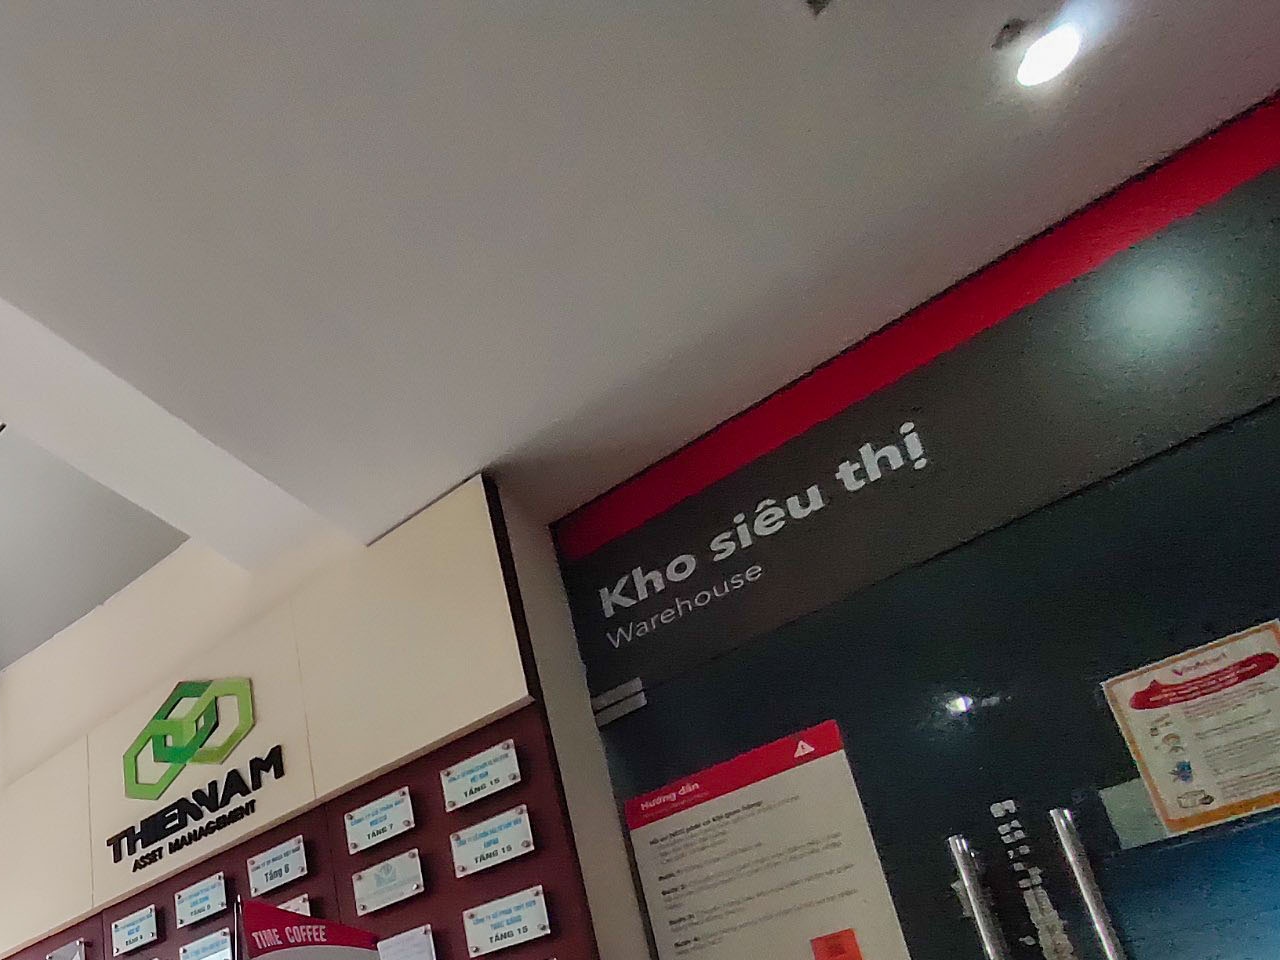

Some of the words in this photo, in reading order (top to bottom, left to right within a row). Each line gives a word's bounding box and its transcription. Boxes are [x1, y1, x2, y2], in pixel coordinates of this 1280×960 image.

[598, 554, 697, 618] Kho
[709, 484, 826, 562] siêu
[835, 421, 927, 491] thị
[606, 564, 763, 648] Warehouse
[132, 847, 163, 873] ASSET
[168, 799, 256, 854] MANAGEMENT
[501, 844, 513, 853] 15
[252, 929, 282, 949] TIME
[284, 925, 327, 944] COFFEE
[517, 926, 529, 935] 15
